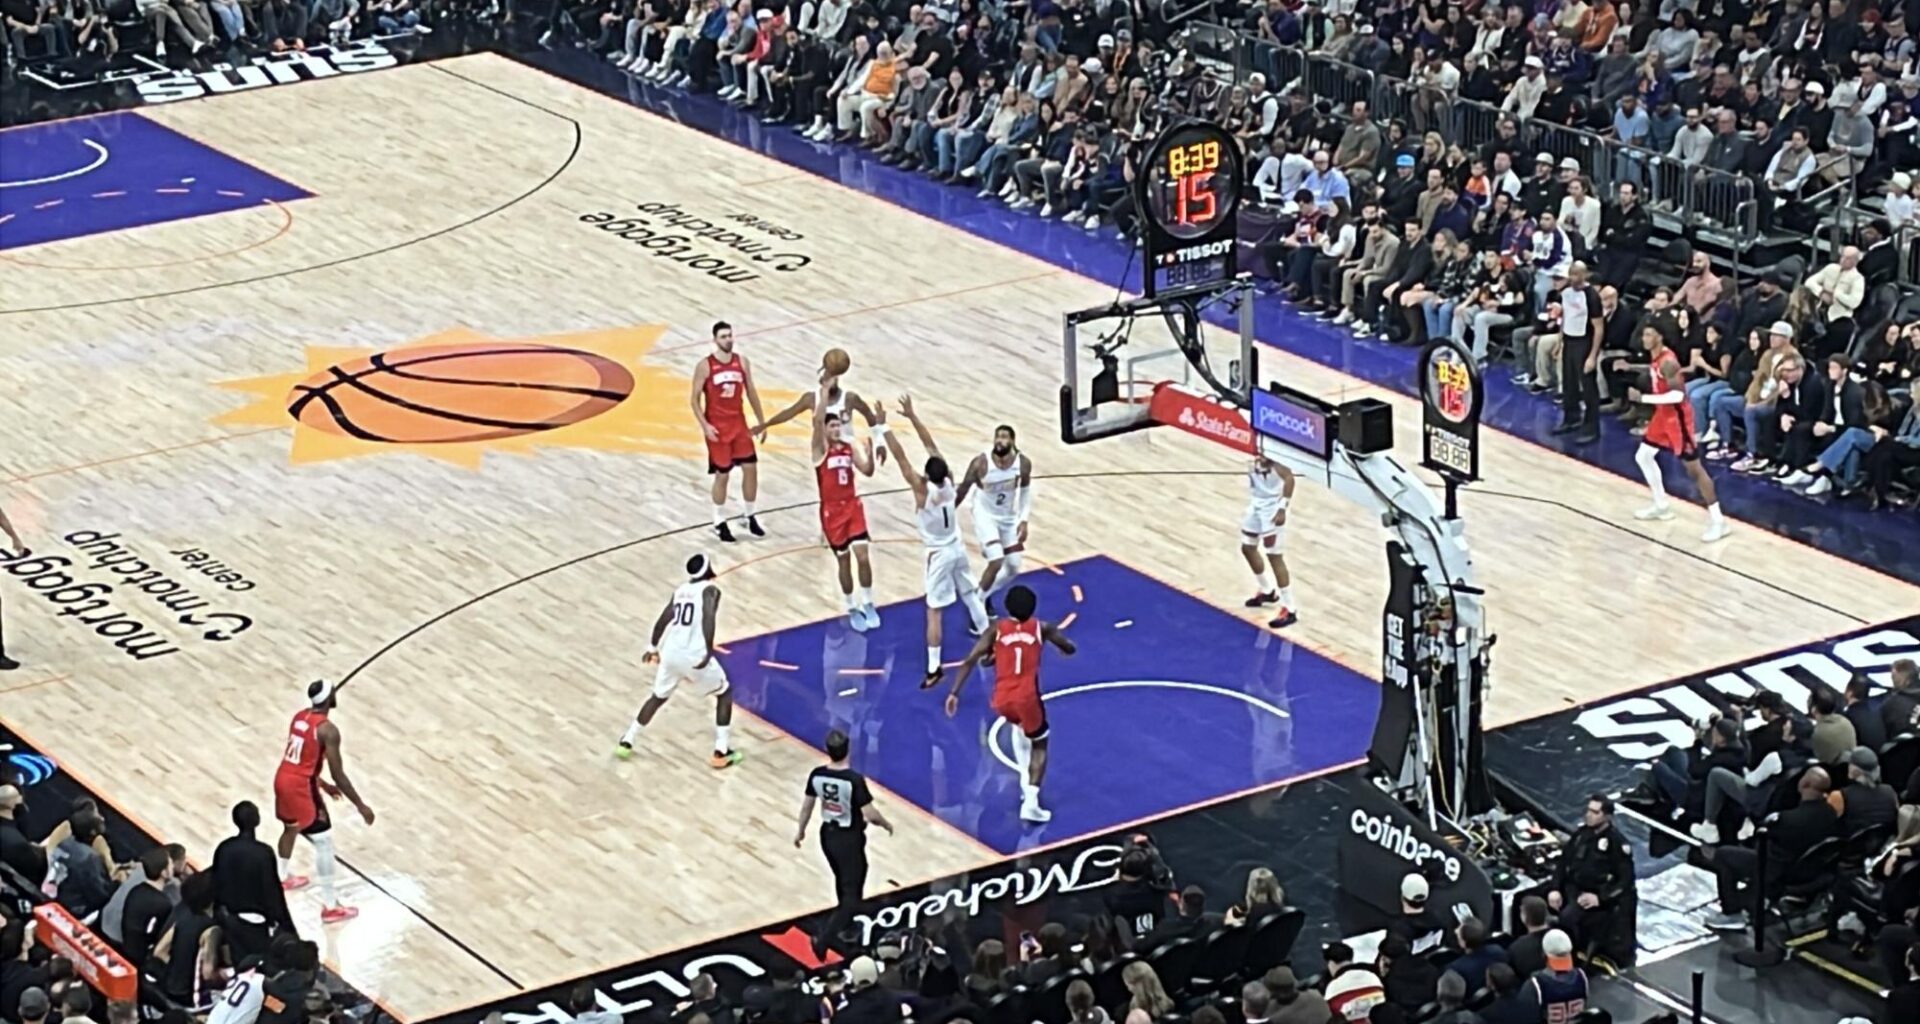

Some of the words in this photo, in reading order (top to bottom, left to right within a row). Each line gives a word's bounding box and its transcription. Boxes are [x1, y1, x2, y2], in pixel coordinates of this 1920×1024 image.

[1169, 141, 1219, 178] 8:39
[1177, 172, 1216, 226] 15
[579, 212, 760, 283] mortgage
[637, 202, 772, 253] matchup
[1176, 239, 1233, 262] TISSOT
[1259, 406, 1315, 439] peacock
[942, 506, 949, 529] 1
[996, 493, 1006, 506] 2
[64, 530, 209, 611] matchup
[170, 548, 256, 592] center
[0, 548, 181, 660] mortgage
[1014, 647, 1022, 674] 1
